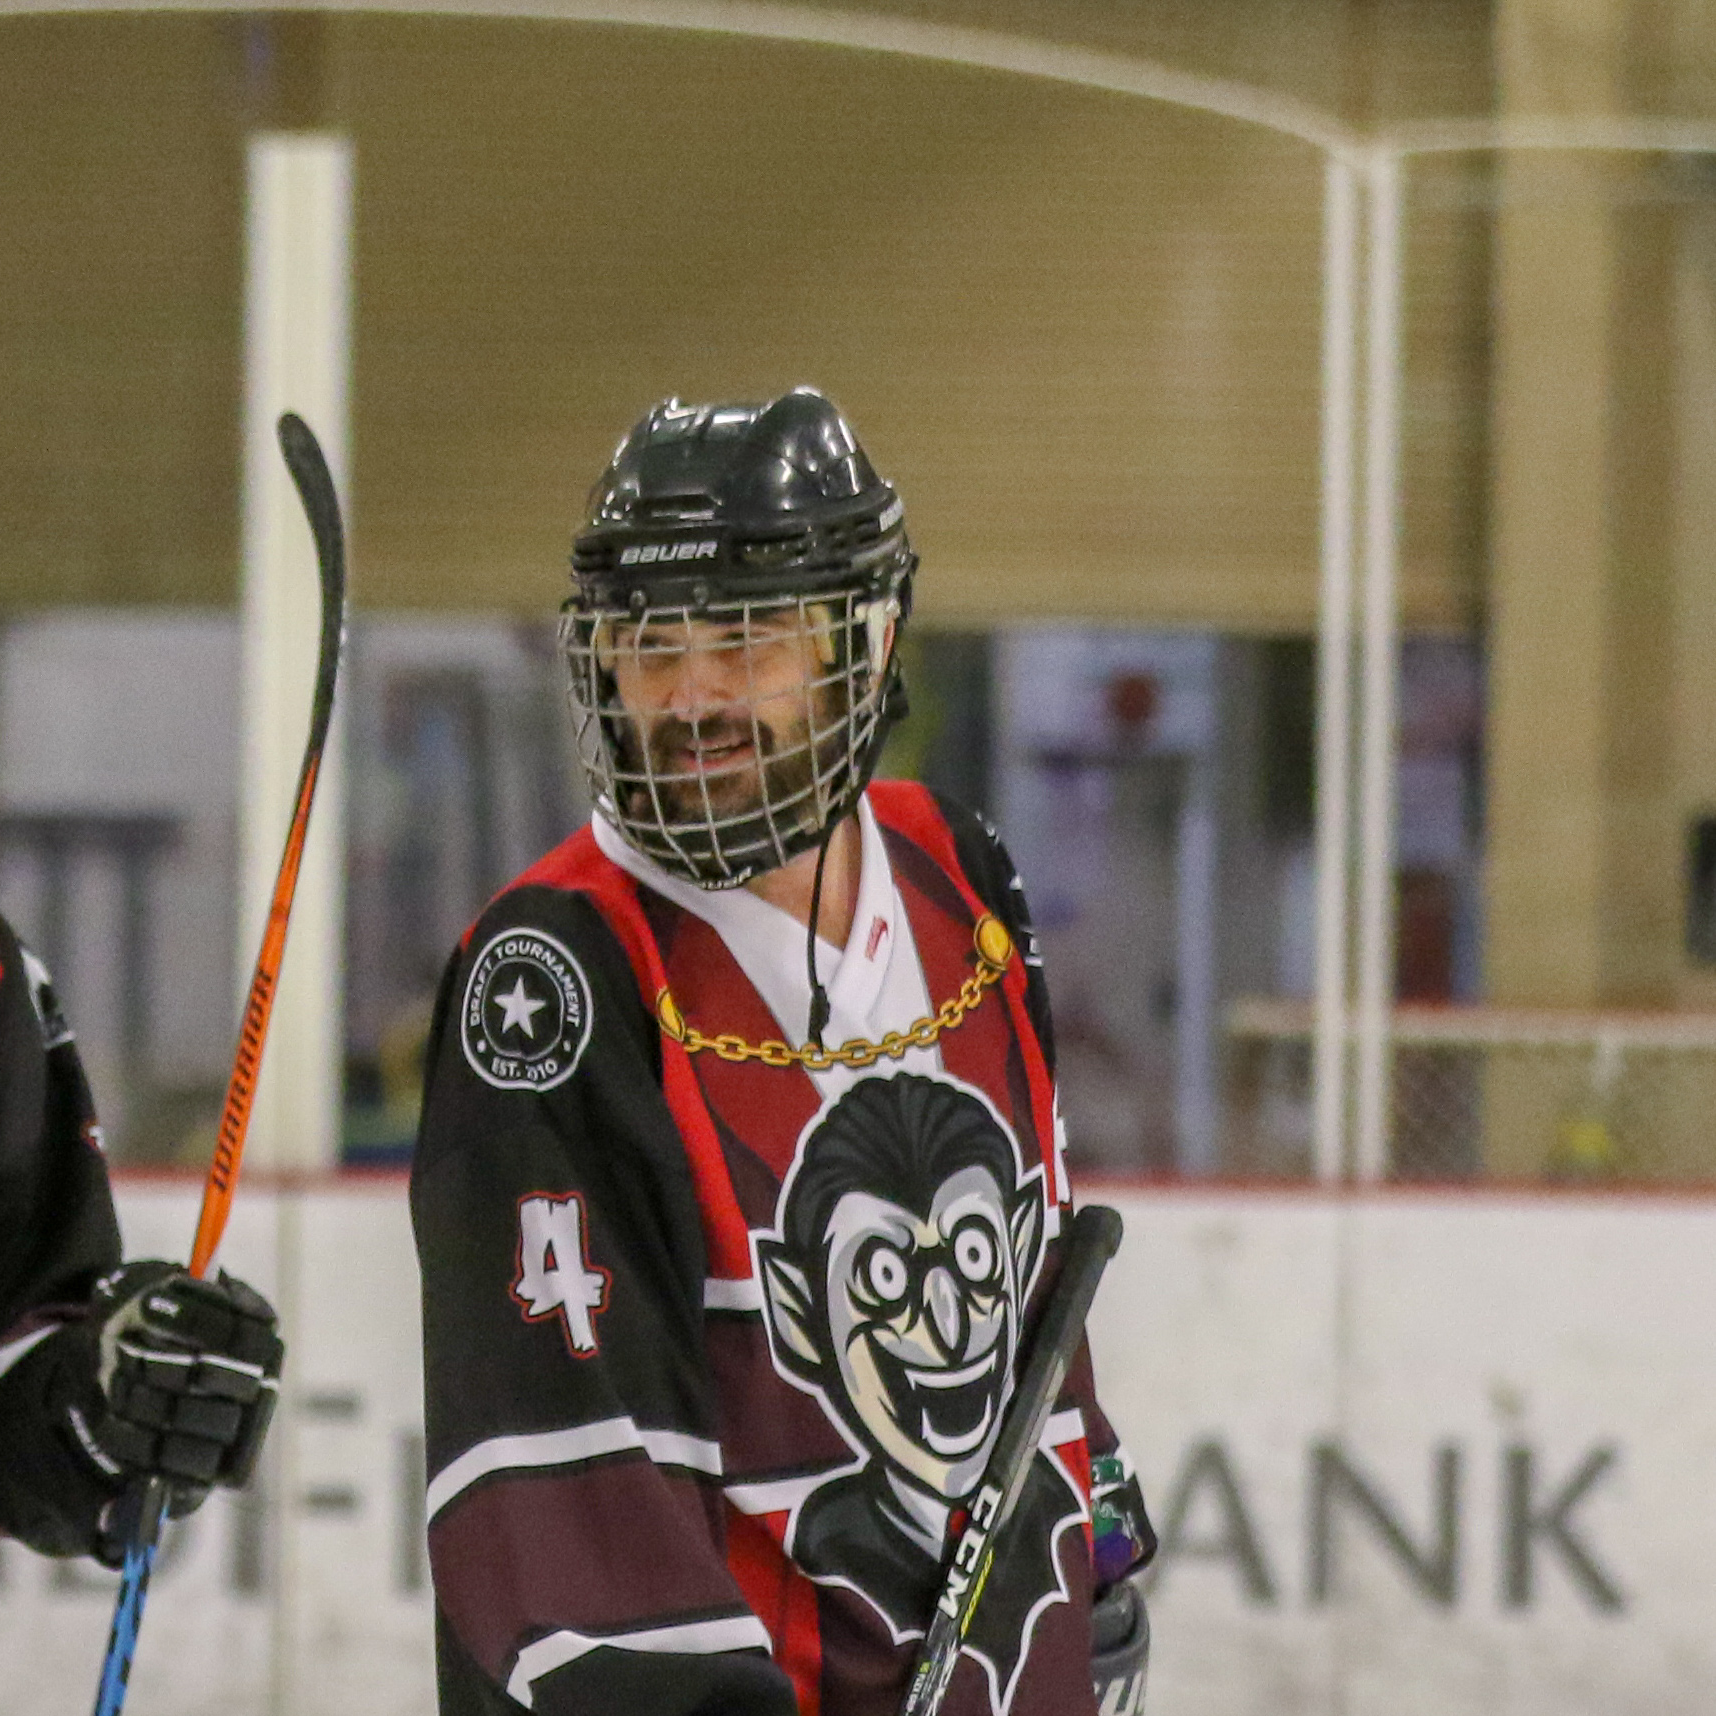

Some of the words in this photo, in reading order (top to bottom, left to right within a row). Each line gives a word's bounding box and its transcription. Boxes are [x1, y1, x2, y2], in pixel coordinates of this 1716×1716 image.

[620, 541, 718, 566] BAUER
[495, 940, 581, 1028] TOURNAMENT
[514, 1197, 607, 1354] 4
[937, 1484, 1003, 1620] CCM
[1149, 1430, 1627, 1613] ANK
